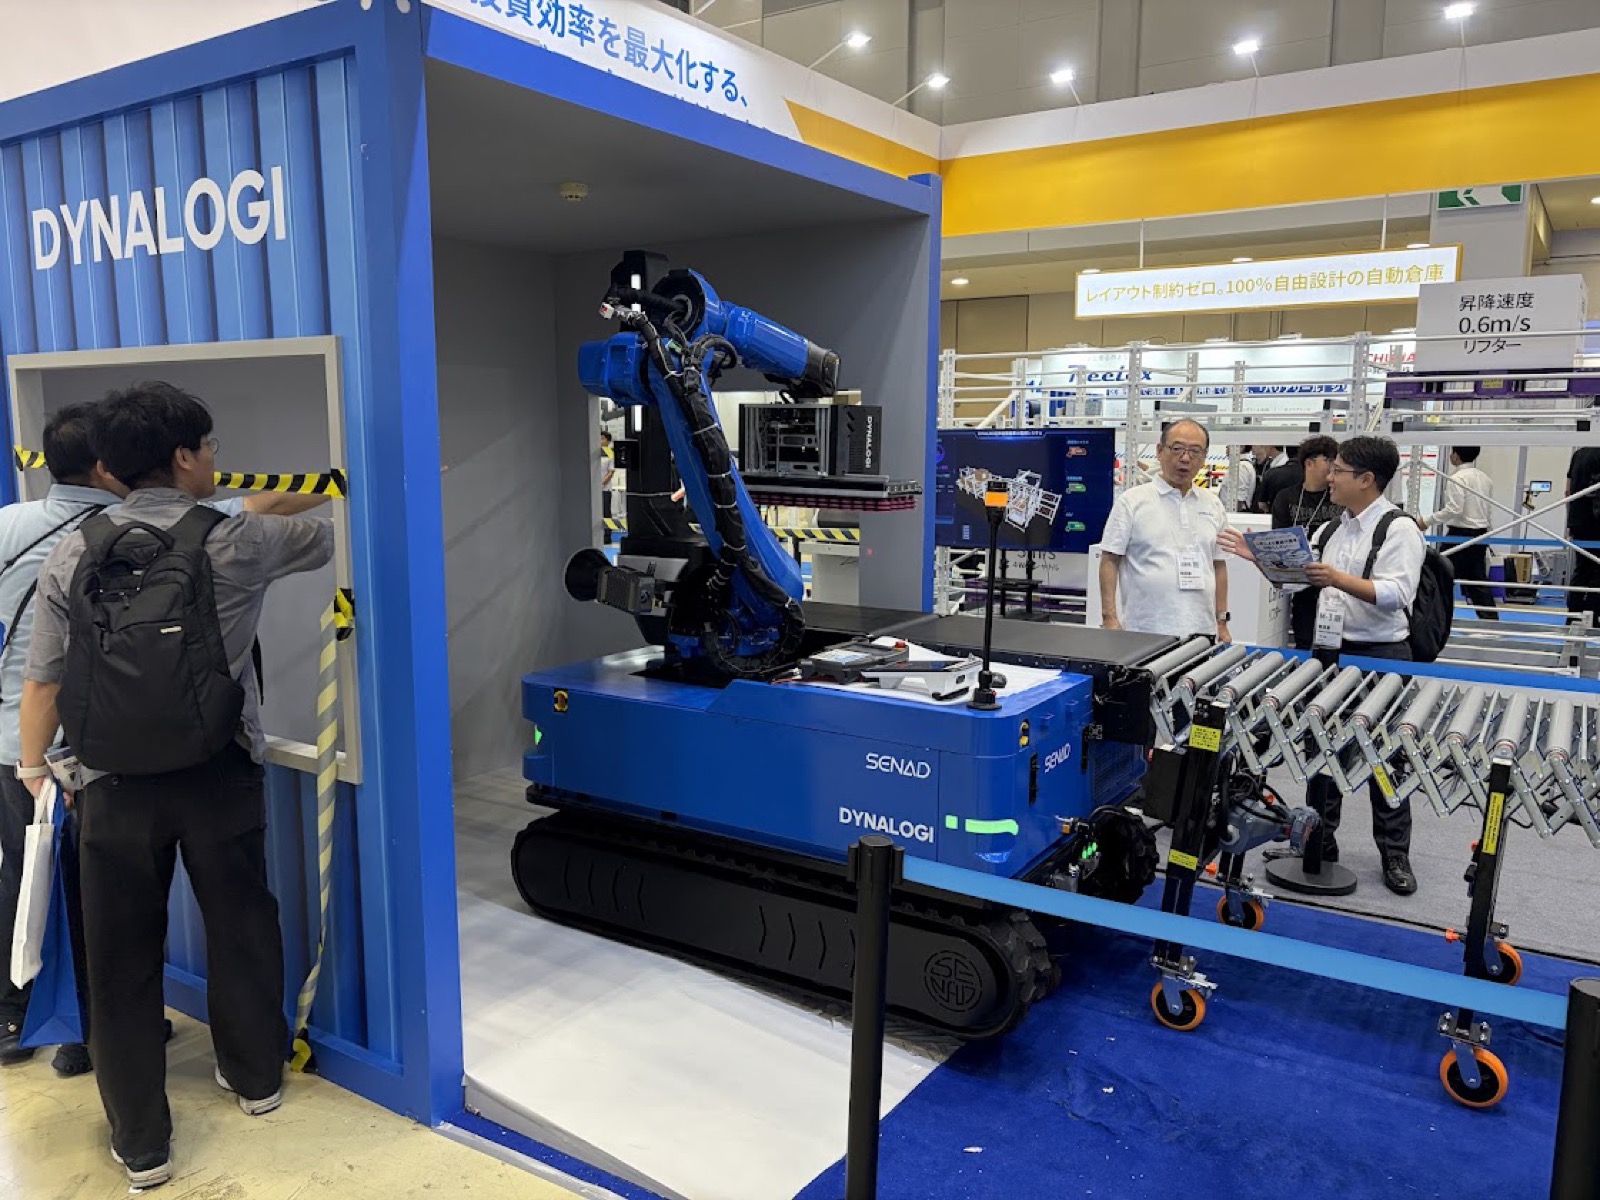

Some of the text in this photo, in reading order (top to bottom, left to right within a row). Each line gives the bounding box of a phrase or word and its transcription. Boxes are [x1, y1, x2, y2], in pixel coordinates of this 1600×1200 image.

[471, 0, 748, 107] 資効率を最大化する、
[32, 166, 286, 270] DYNALOGI
[1459, 291, 1535, 312] 昇降速度
[1459, 314, 1531, 334] 0.6m/s
[1464, 337, 1522, 355] リフター
[865, 415, 873, 469] DYNALOGI
[865, 752, 931, 779] SENAD
[1044, 743, 1071, 774] SENAD
[839, 807, 935, 843] DYNALOGI
